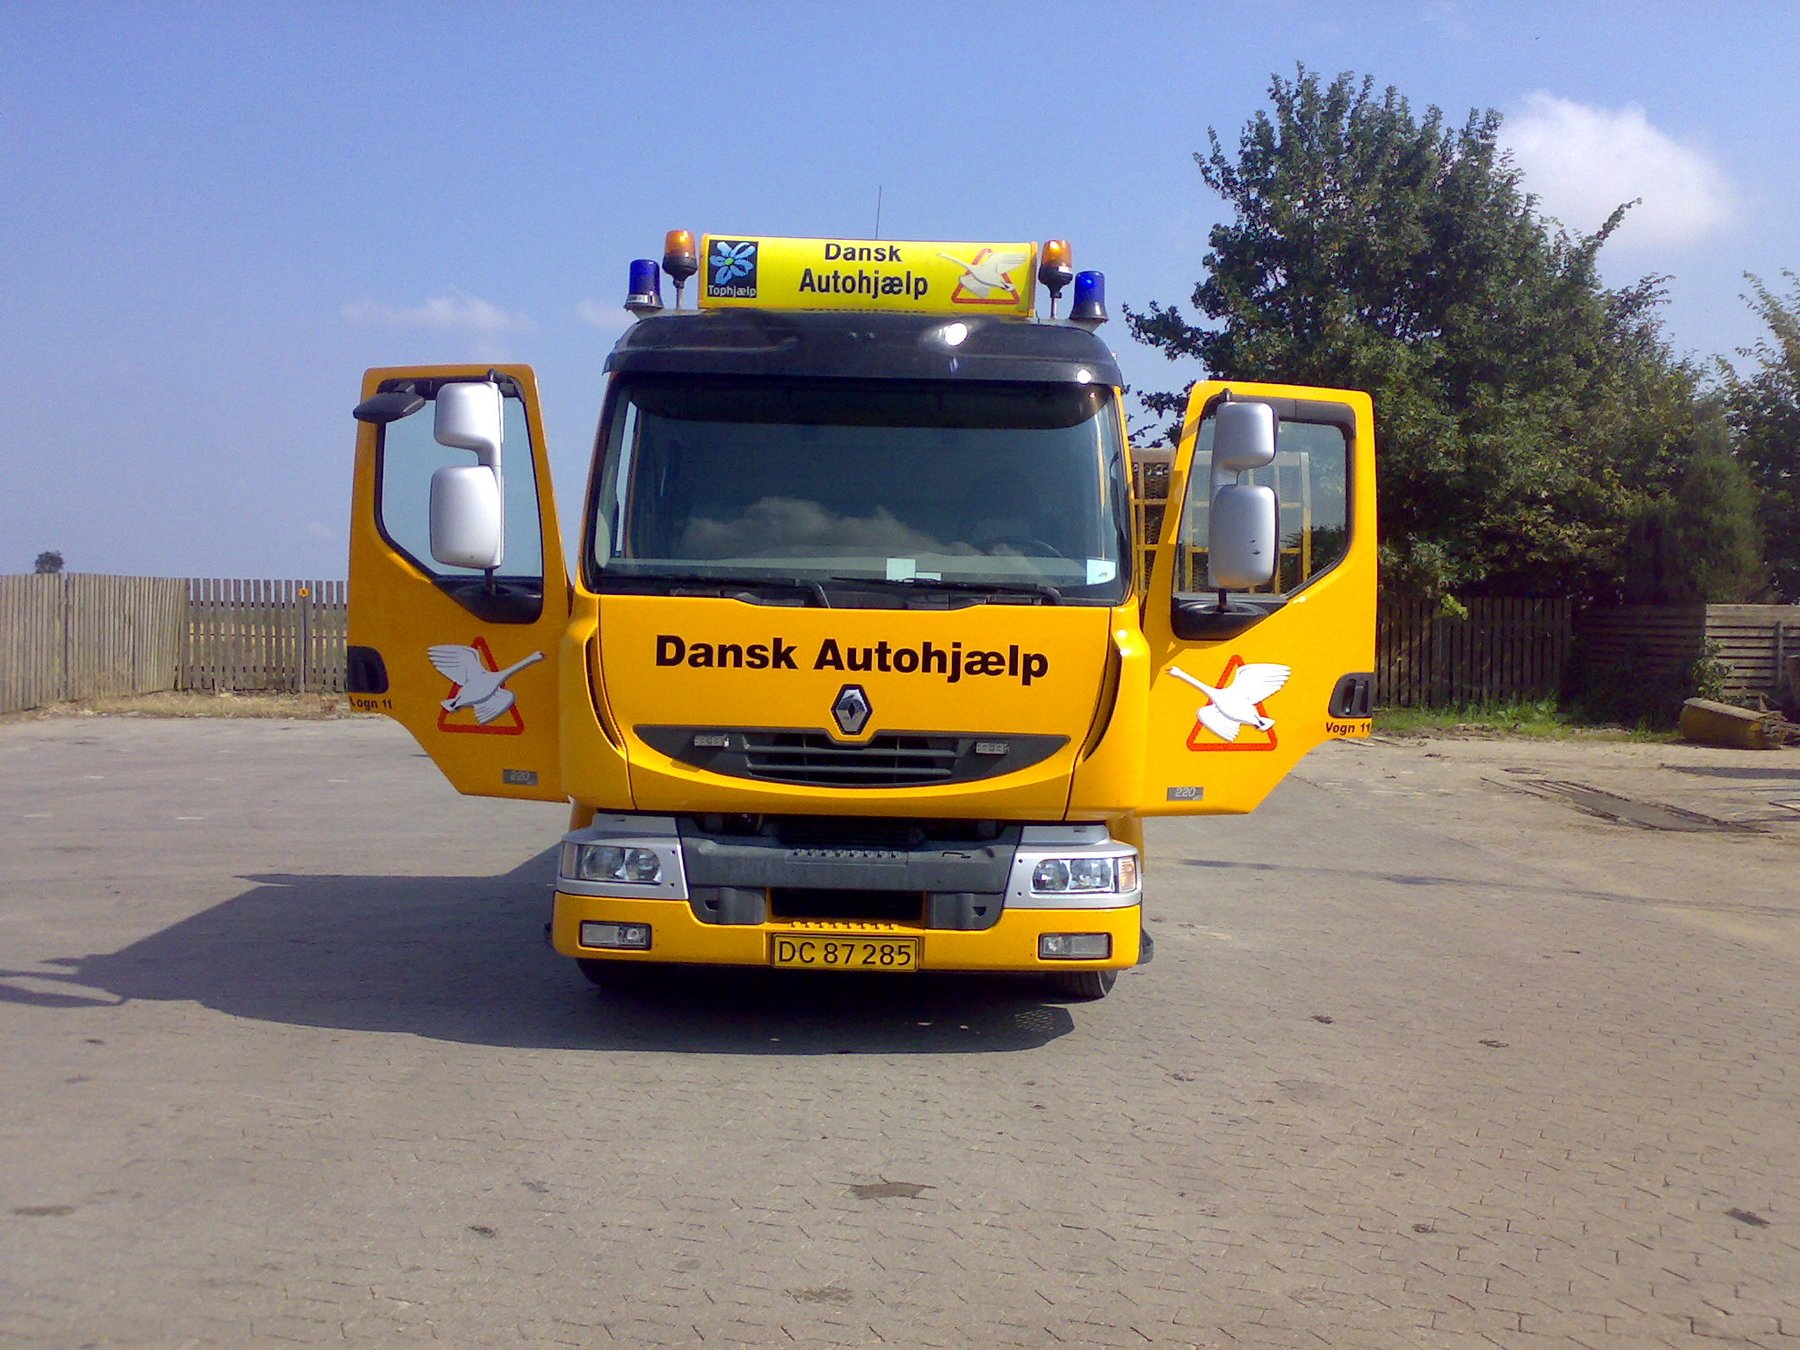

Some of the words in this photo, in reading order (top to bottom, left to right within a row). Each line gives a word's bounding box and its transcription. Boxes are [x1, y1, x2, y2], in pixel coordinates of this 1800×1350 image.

[825, 243, 902, 262] Dansk
[708, 285, 756, 297] Tophjælp
[799, 268, 928, 300] Autohjælp
[656, 635, 799, 670] Dansk
[813, 639, 1049, 686] Autohjælp
[1326, 722, 1355, 736] Vogn
[1361, 722, 1370, 733] 11
[1175, 787, 1196, 797] 220
[779, 941, 816, 963] DC
[823, 943, 856, 964] 87
[862, 944, 911, 965] 285
